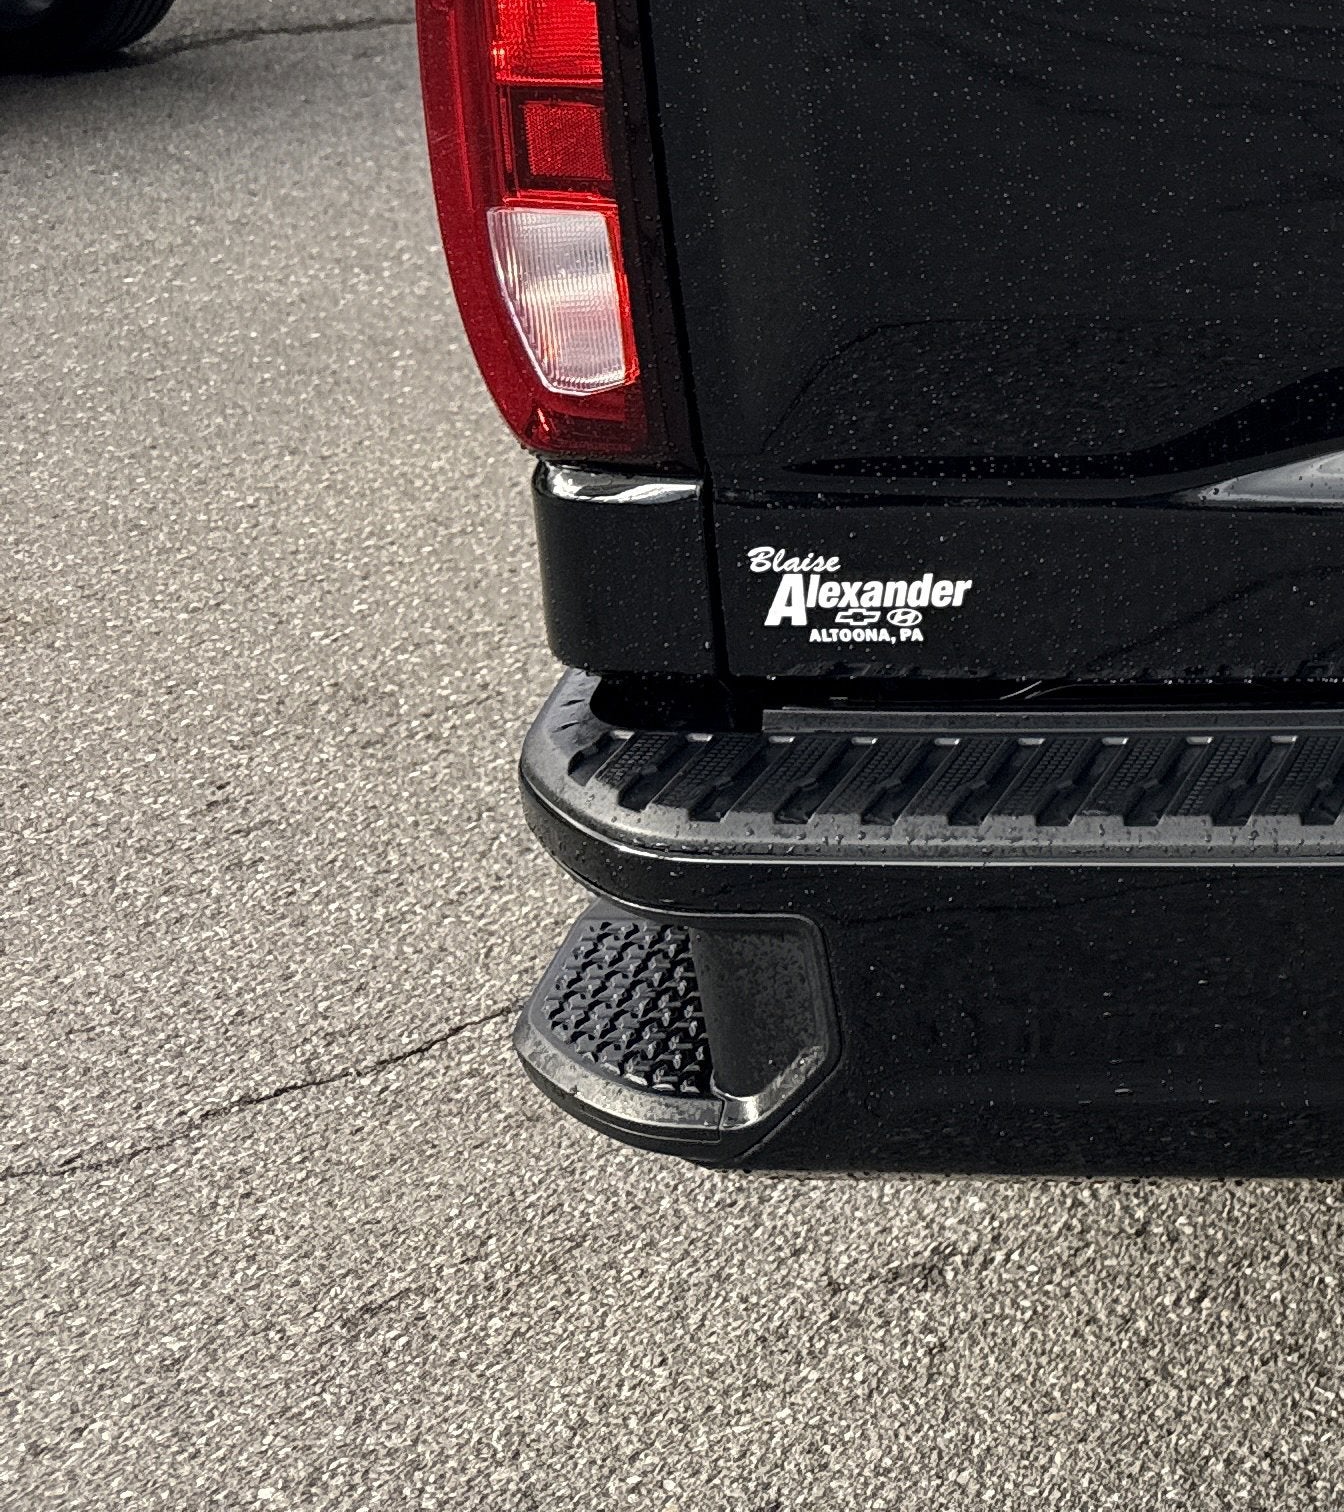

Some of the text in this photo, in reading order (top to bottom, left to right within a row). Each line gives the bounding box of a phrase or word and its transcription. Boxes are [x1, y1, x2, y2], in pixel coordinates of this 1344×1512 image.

[748, 546, 841, 573] Blaise
[764, 573, 973, 626] Alexander
[809, 628, 924, 645] ALTOONA, PA
